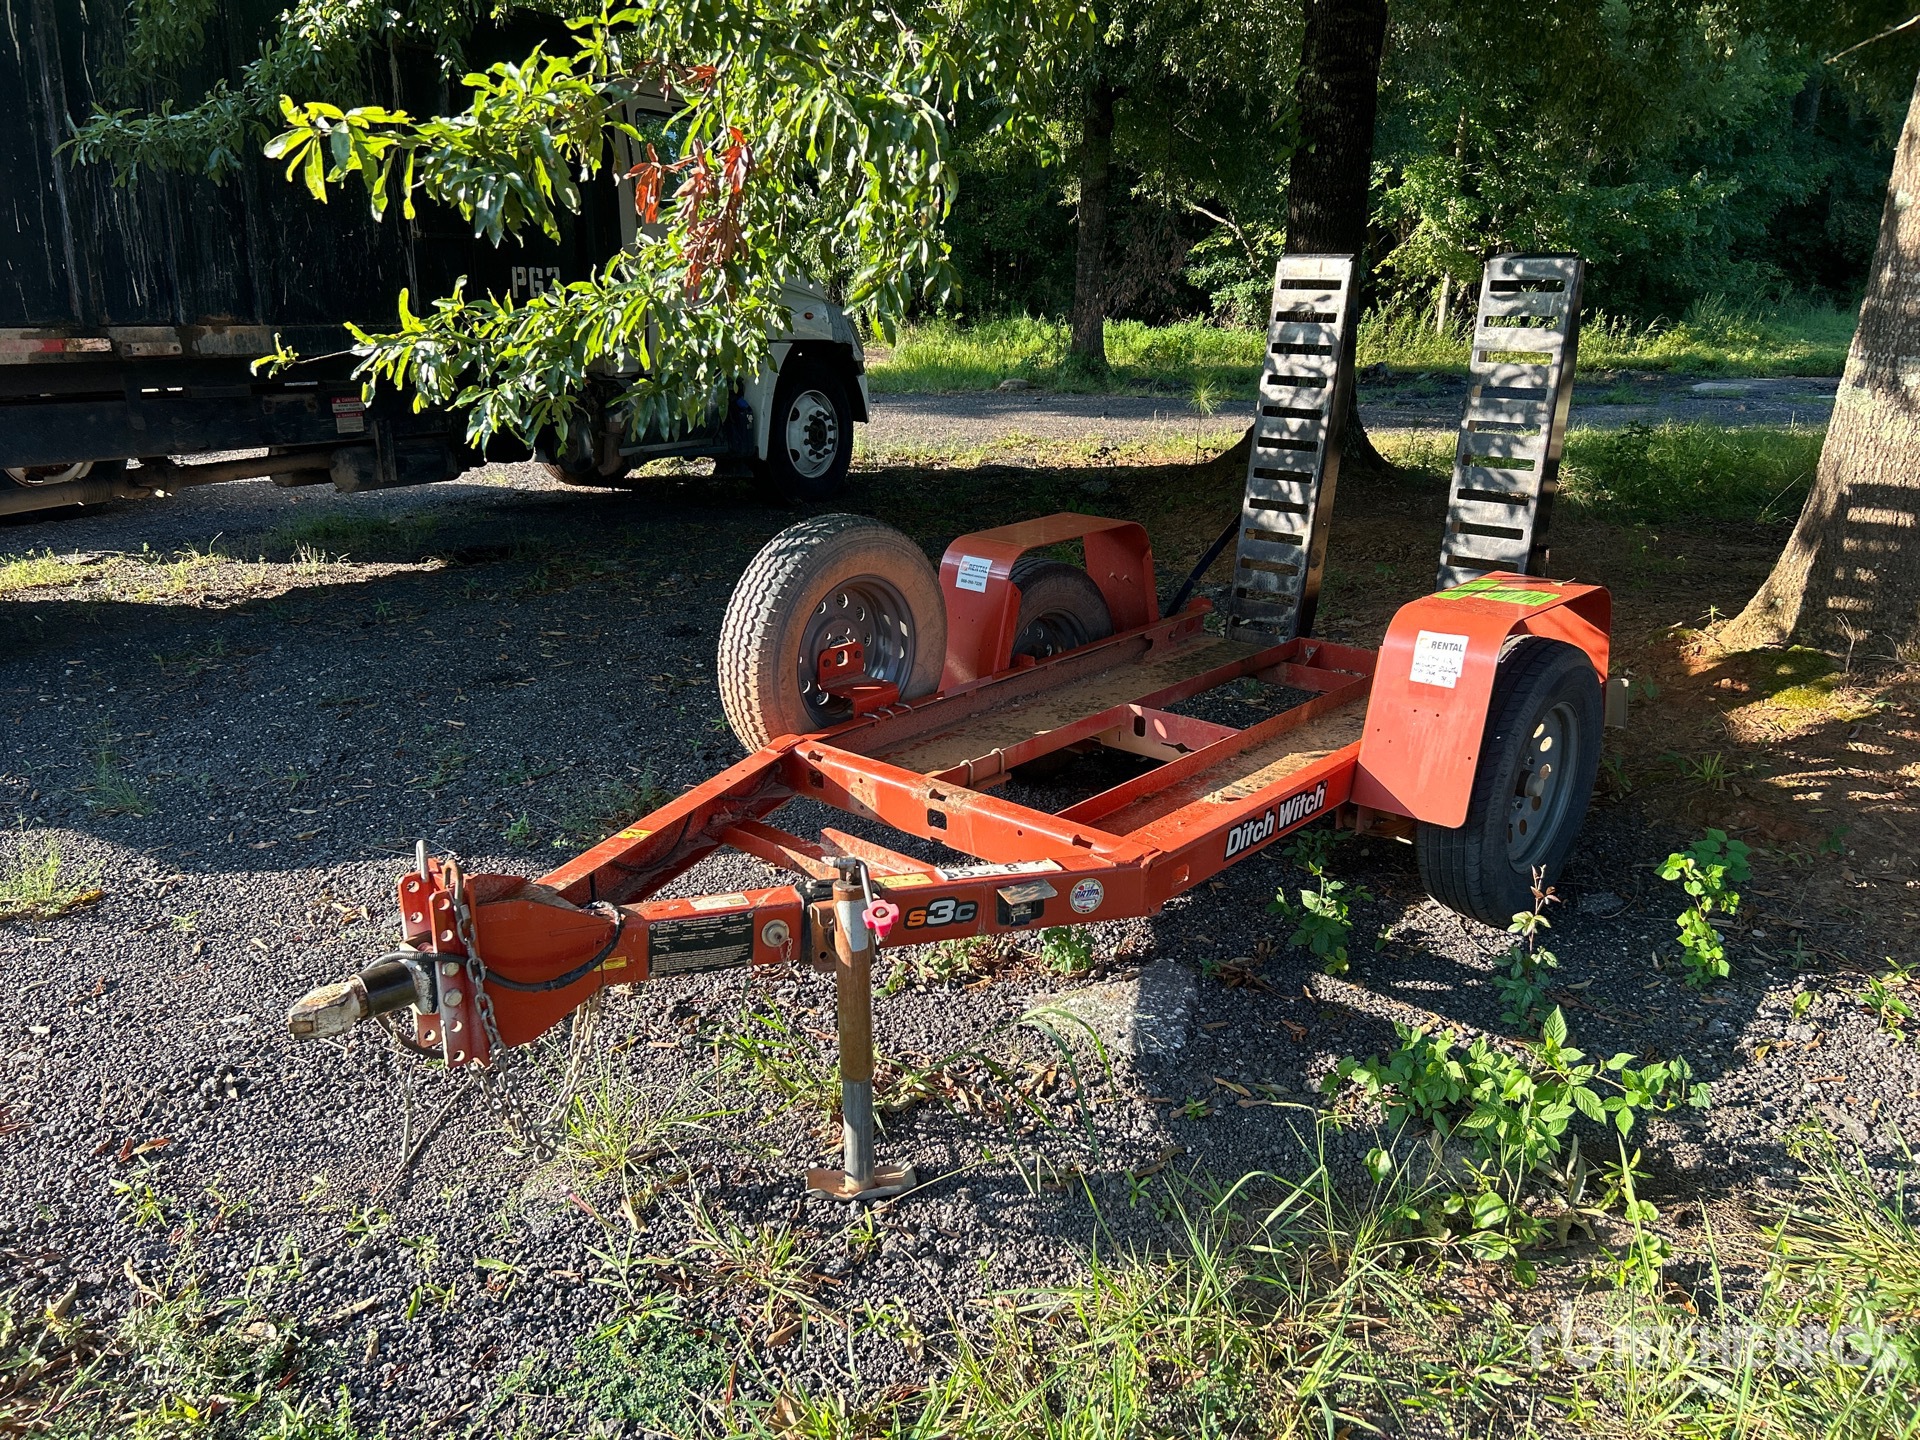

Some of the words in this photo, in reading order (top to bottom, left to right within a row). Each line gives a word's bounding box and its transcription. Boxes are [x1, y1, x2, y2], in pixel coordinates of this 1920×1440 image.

[968, 563, 987, 573] RENTAL
[1431, 640, 1463, 652] RENTAL
[1225, 810, 1275, 858] Ditch
[1278, 784, 1326, 829] Witch
